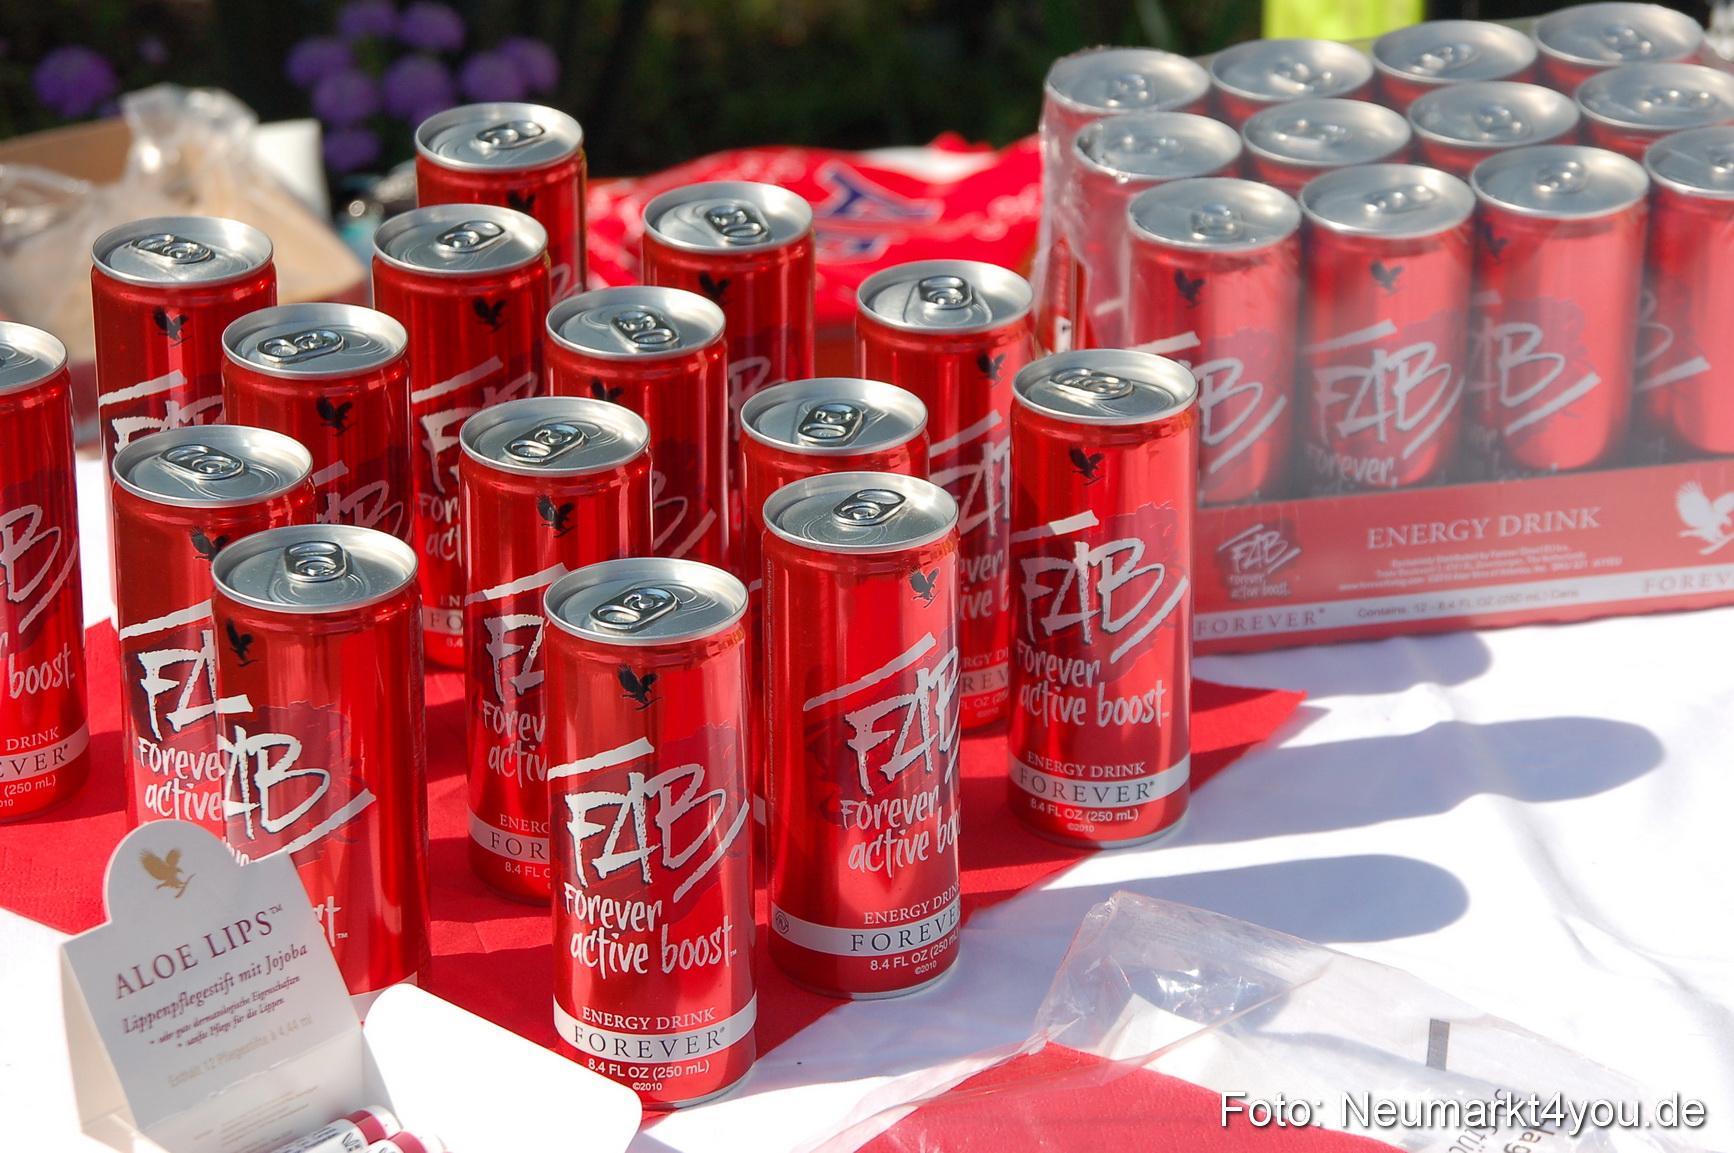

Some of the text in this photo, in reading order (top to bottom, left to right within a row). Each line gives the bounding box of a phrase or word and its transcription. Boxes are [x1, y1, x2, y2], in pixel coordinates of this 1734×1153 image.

[1367, 506, 1602, 550] ENERGY DRINK
[1642, 571, 1734, 594] FOREV
[1017, 639, 1101, 690] Forever
[1020, 680, 1087, 728] active
[6, 726, 60, 752] DRINK
[1027, 751, 1146, 779] ENERGY DRINK
[4, 774, 57, 797] (250 mL)
[840, 785, 940, 832] Forever
[1030, 798, 1139, 823] 8.4 FL OZ (250 mL)
[505, 861, 521, 874] 8.4
[524, 864, 542, 879] FL
[848, 828, 930, 880] active
[564, 881, 663, 933] Forever
[863, 899, 930, 926] ENERGY
[850, 903, 958, 952] FOREVE
[116, 943, 199, 1000] ALOE
[571, 926, 649, 980] active
[869, 957, 889, 972] 8.4
[893, 953, 910, 969] FL
[911, 948, 928, 964] OZ
[930, 938, 949, 960] (250
[121, 943, 308, 1034] Lippenpflegestift mit Jojoba
[582, 1005, 716, 1032] ENERGY DRINK
[588, 1058, 710, 1081] 8.4 FL OZ (250 mL)
